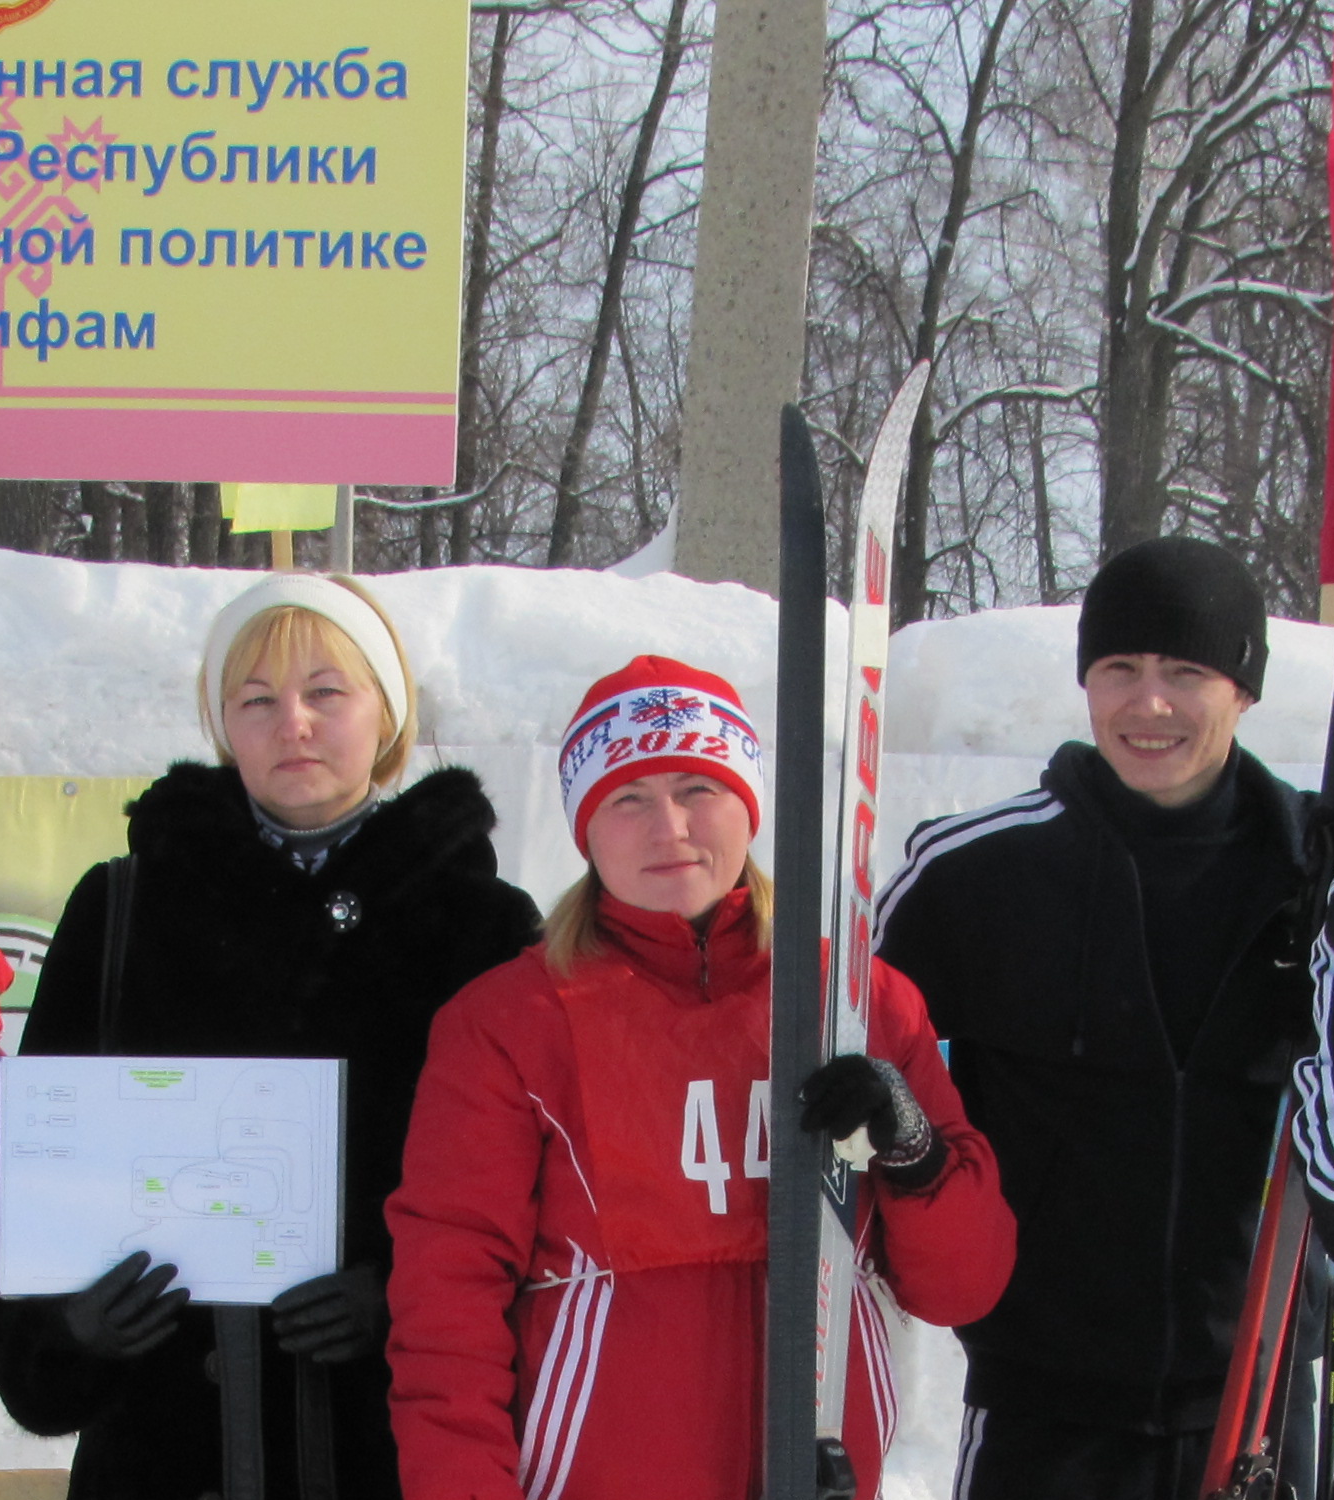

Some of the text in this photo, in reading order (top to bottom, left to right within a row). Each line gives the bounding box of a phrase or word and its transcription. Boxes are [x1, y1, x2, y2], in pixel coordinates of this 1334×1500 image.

[165, 48, 410, 110] служба
[118, 222, 429, 271] политике
[605, 730, 730, 770] 2012
